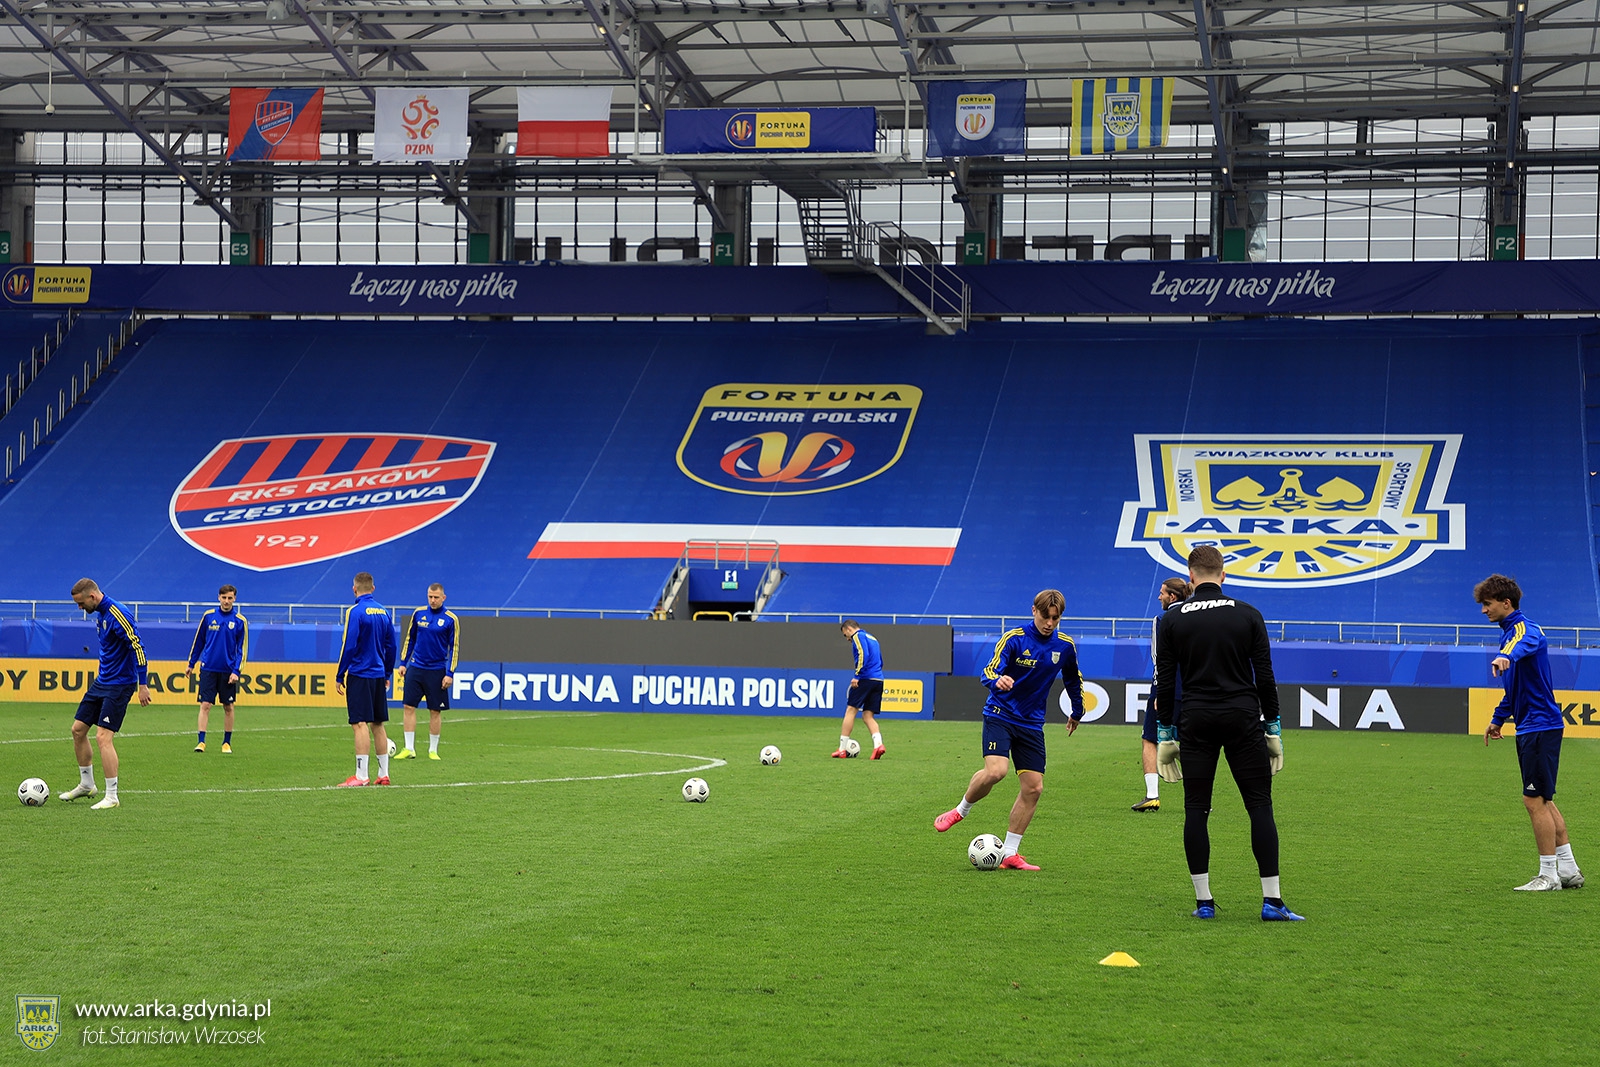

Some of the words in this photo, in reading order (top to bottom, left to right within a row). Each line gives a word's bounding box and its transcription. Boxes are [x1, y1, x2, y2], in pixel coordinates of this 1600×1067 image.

[404, 144, 434, 155] PZPN
[231, 243, 249, 256] E3
[715, 244, 733, 257] F1
[965, 242, 983, 256] F1
[1495, 237, 1516, 250] F2
[349, 271, 417, 307] Łączy
[418, 279, 460, 300] nas
[455, 271, 518, 307] piłka
[1150, 270, 1224, 306] Łączy
[1226, 277, 1272, 299] nas
[1266, 269, 1336, 307] piłka
[720, 390, 903, 401] FORTUNA
[710, 410, 805, 423] PUCHAR
[811, 411, 898, 423] POLSKI
[1194, 450, 1328, 459] ZWIĄZKOWY
[227, 483, 299, 503] RKS
[305, 466, 442, 494] RAKÓW
[1177, 468, 1196, 502] MORSKI
[1383, 461, 1412, 510] SPORTOWY
[203, 484, 447, 523] CZĘSTOCHOWA
[1181, 517, 1400, 535] ARKA
[253, 534, 320, 548] 1921
[724, 570, 738, 582] F1
[1180, 599, 1236, 614] GDYNIA
[452, 672, 620, 703] FORTUNA
[631, 674, 736, 706] PUCHAR
[741, 677, 835, 709] POLSKI
[988, 741, 997, 750] 21
